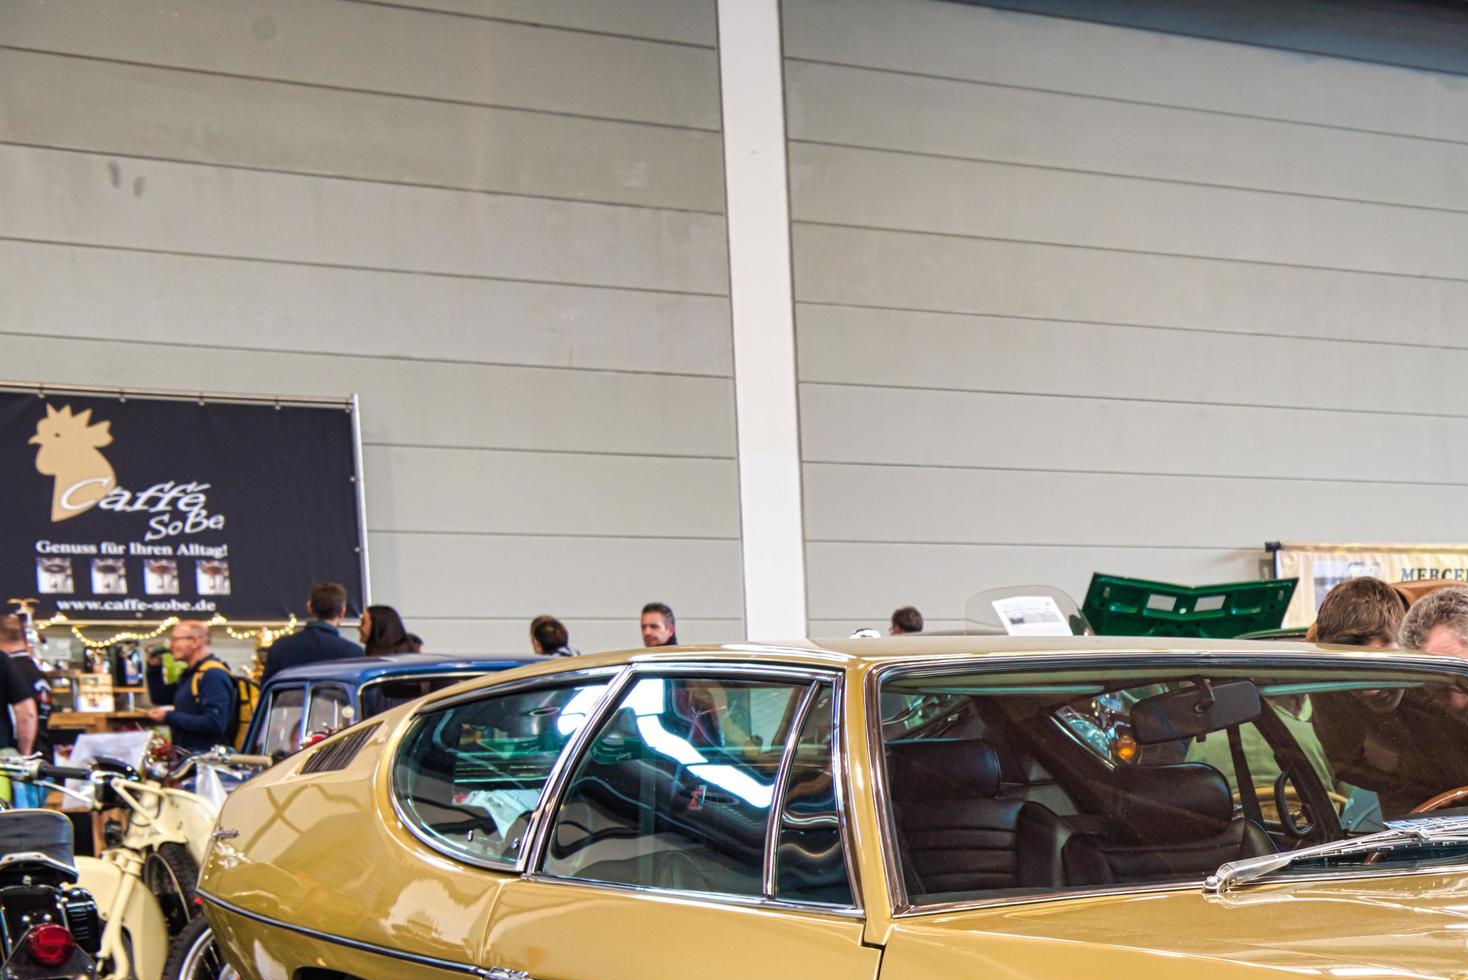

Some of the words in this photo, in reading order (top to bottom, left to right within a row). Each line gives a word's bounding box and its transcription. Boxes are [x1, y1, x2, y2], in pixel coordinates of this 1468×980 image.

[36, 540, 97, 554] Genuss
[101, 541, 125, 555] für
[129, 542, 173, 556] Ihren
[177, 543, 229, 559] Alltag!
[57, 599, 216, 612] www.caffe-sobe.de
